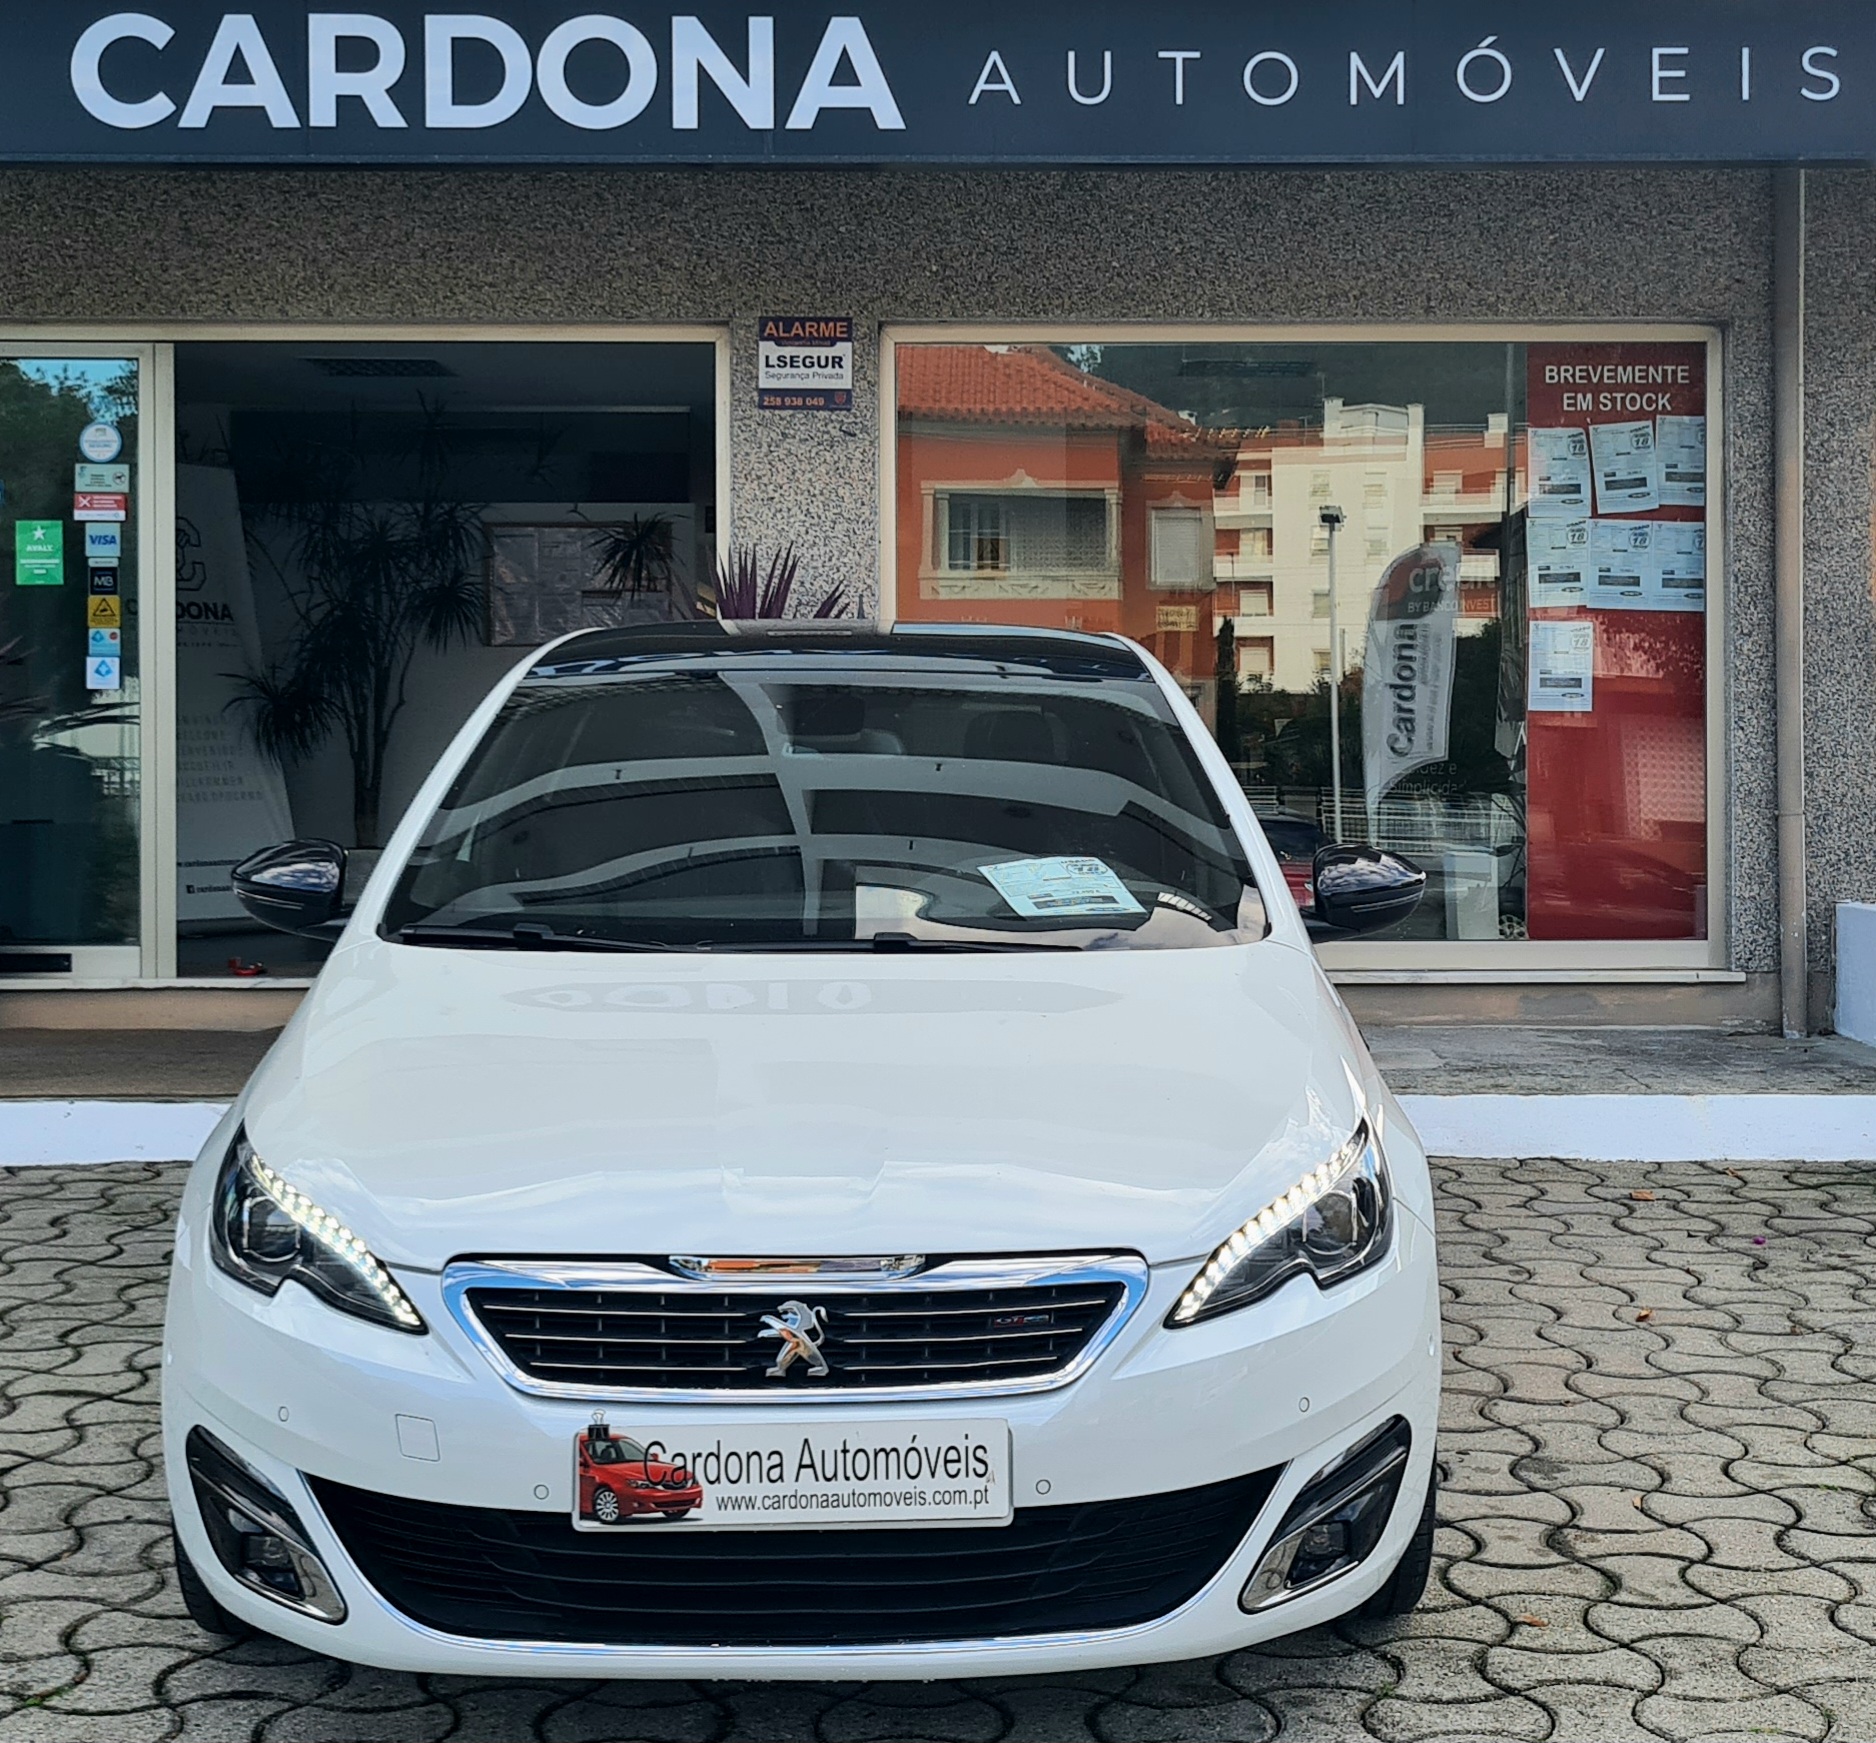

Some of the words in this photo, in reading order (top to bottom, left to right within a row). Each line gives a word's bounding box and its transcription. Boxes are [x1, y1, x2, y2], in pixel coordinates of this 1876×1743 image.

[70, 12, 907, 130] CARDONA
[967, 36, 1842, 106] AUTOMÓVEIS
[764, 321, 849, 338] ALARME
[765, 355, 844, 369] LSEGUR
[765, 371, 810, 381] Segurança
[812, 371, 844, 380] Privada
[1545, 365, 1690, 384] BREVEMENTE
[785, 397, 803, 406] 938
[1563, 393, 1593, 411] EM
[1599, 393, 1672, 411] STOCK
[89, 534, 118, 545] VISA
[94, 576, 114, 587] MB
[1385, 624, 1417, 758] Cardona
[644, 1439, 784, 1487] Cardona
[795, 1434, 989, 1483] Automóveis
[716, 1485, 990, 1512] www.cardonaautomoveis.com.pt
